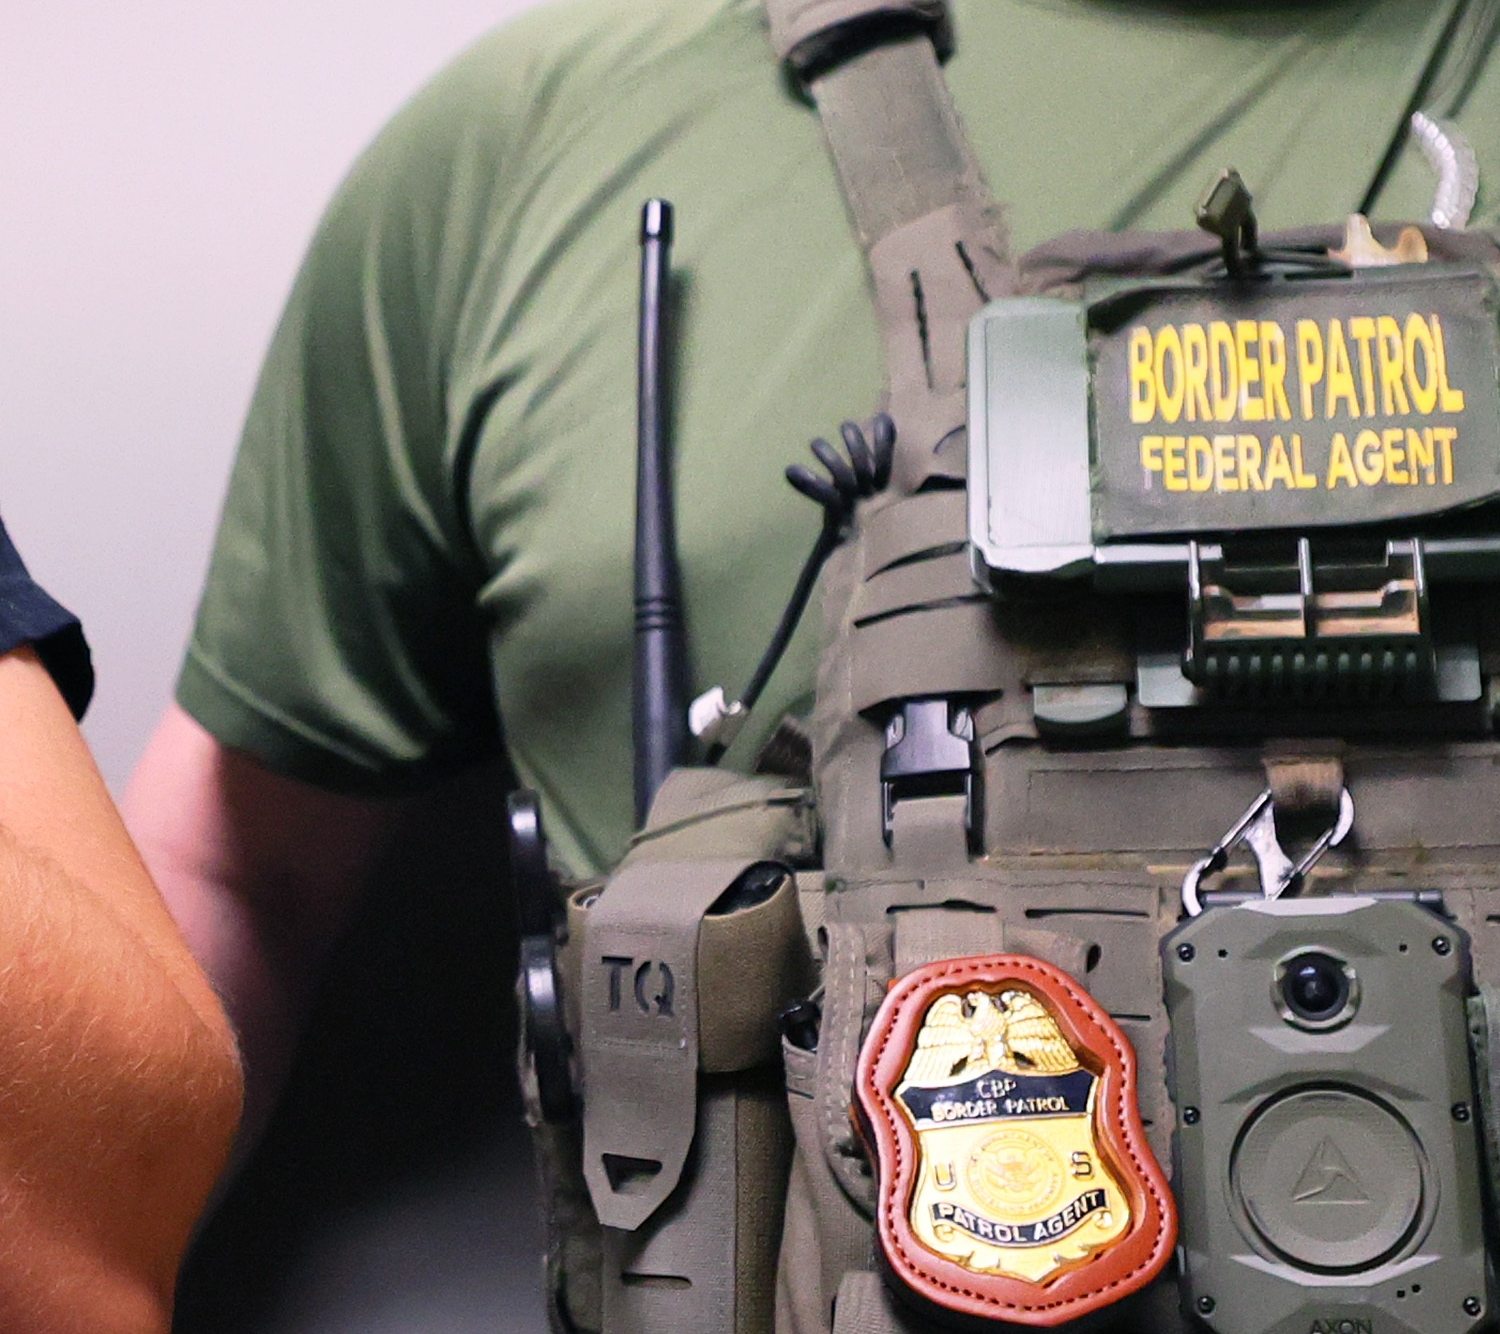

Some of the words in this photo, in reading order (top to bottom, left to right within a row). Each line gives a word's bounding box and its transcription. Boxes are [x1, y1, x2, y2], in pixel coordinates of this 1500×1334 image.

[1129, 320, 1290, 424] BORDER
[1297, 313, 1465, 419] PATROL
[1141, 434, 1318, 493] FEDERAL
[1328, 427, 1458, 488] AGENT
[601, 955, 675, 1017] TQ
[931, 1100, 997, 1120] BORDER
[1005, 1096, 1070, 1115] PATROL
[933, 1161, 957, 1191] U
[1071, 1150, 1095, 1182] S
[939, 1203, 1027, 1242] PATROL
[1033, 1192, 1101, 1241] AGENT
